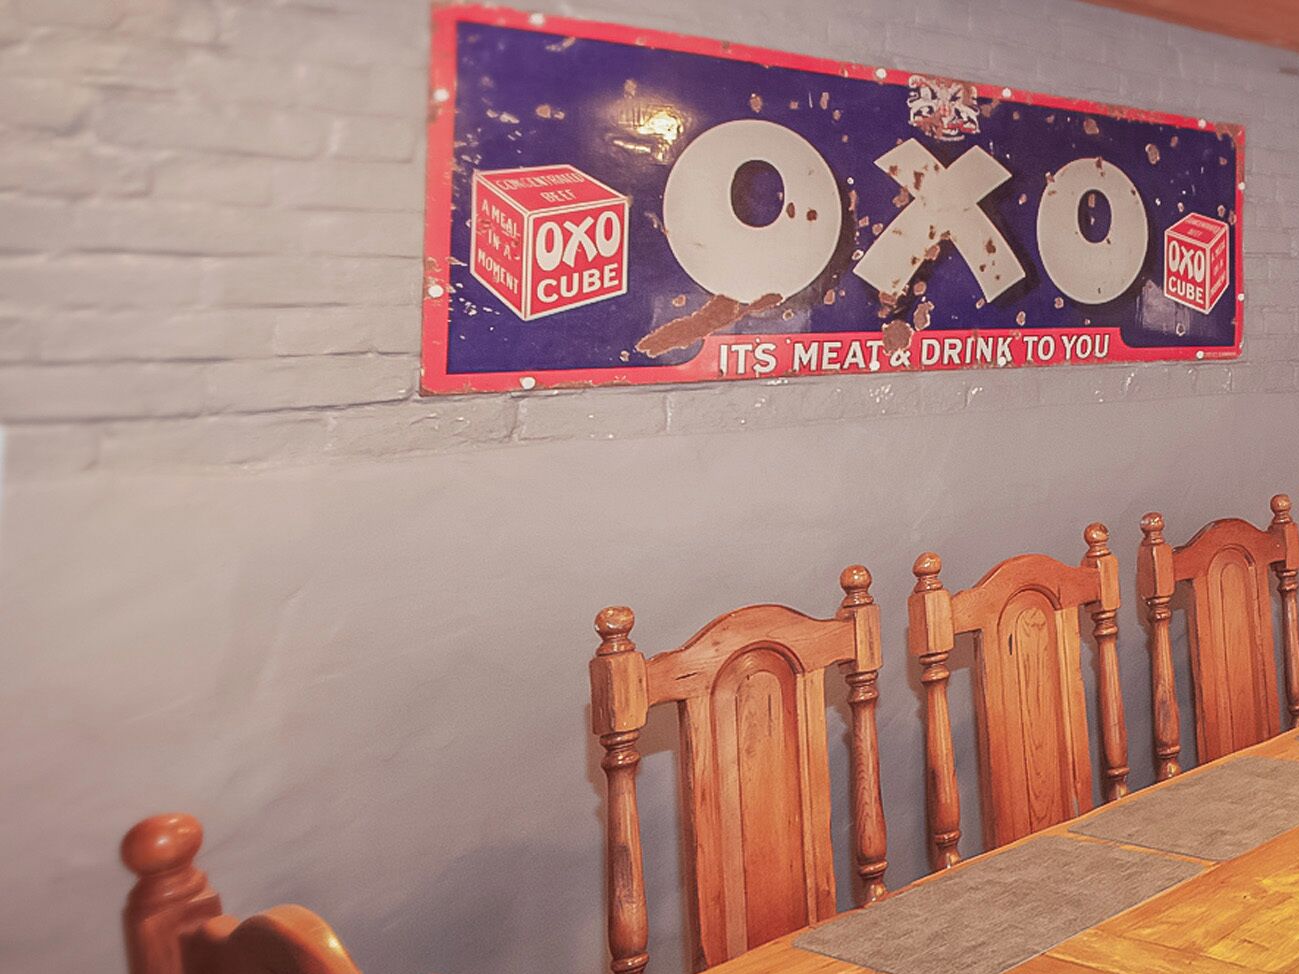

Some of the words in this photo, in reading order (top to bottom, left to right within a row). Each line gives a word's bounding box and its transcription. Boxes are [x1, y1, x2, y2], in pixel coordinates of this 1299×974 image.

[482, 199, 490, 216] A
[664, 119, 1148, 304] OXO
[489, 229, 500, 250] IN
[503, 244, 512, 260] A
[536, 211, 621, 271] OXO
[478, 248, 518, 294] MOMENT
[1168, 240, 1205, 283] OXO
[537, 263, 619, 303] CUBE
[1168, 276, 1204, 304] CUBE
[793, 340, 885, 372] MEAT
[890, 348, 911, 367] &
[921, 336, 1013, 366] DRINK
[1023, 335, 1055, 361] TO
[1061, 334, 1110, 361] YOU
